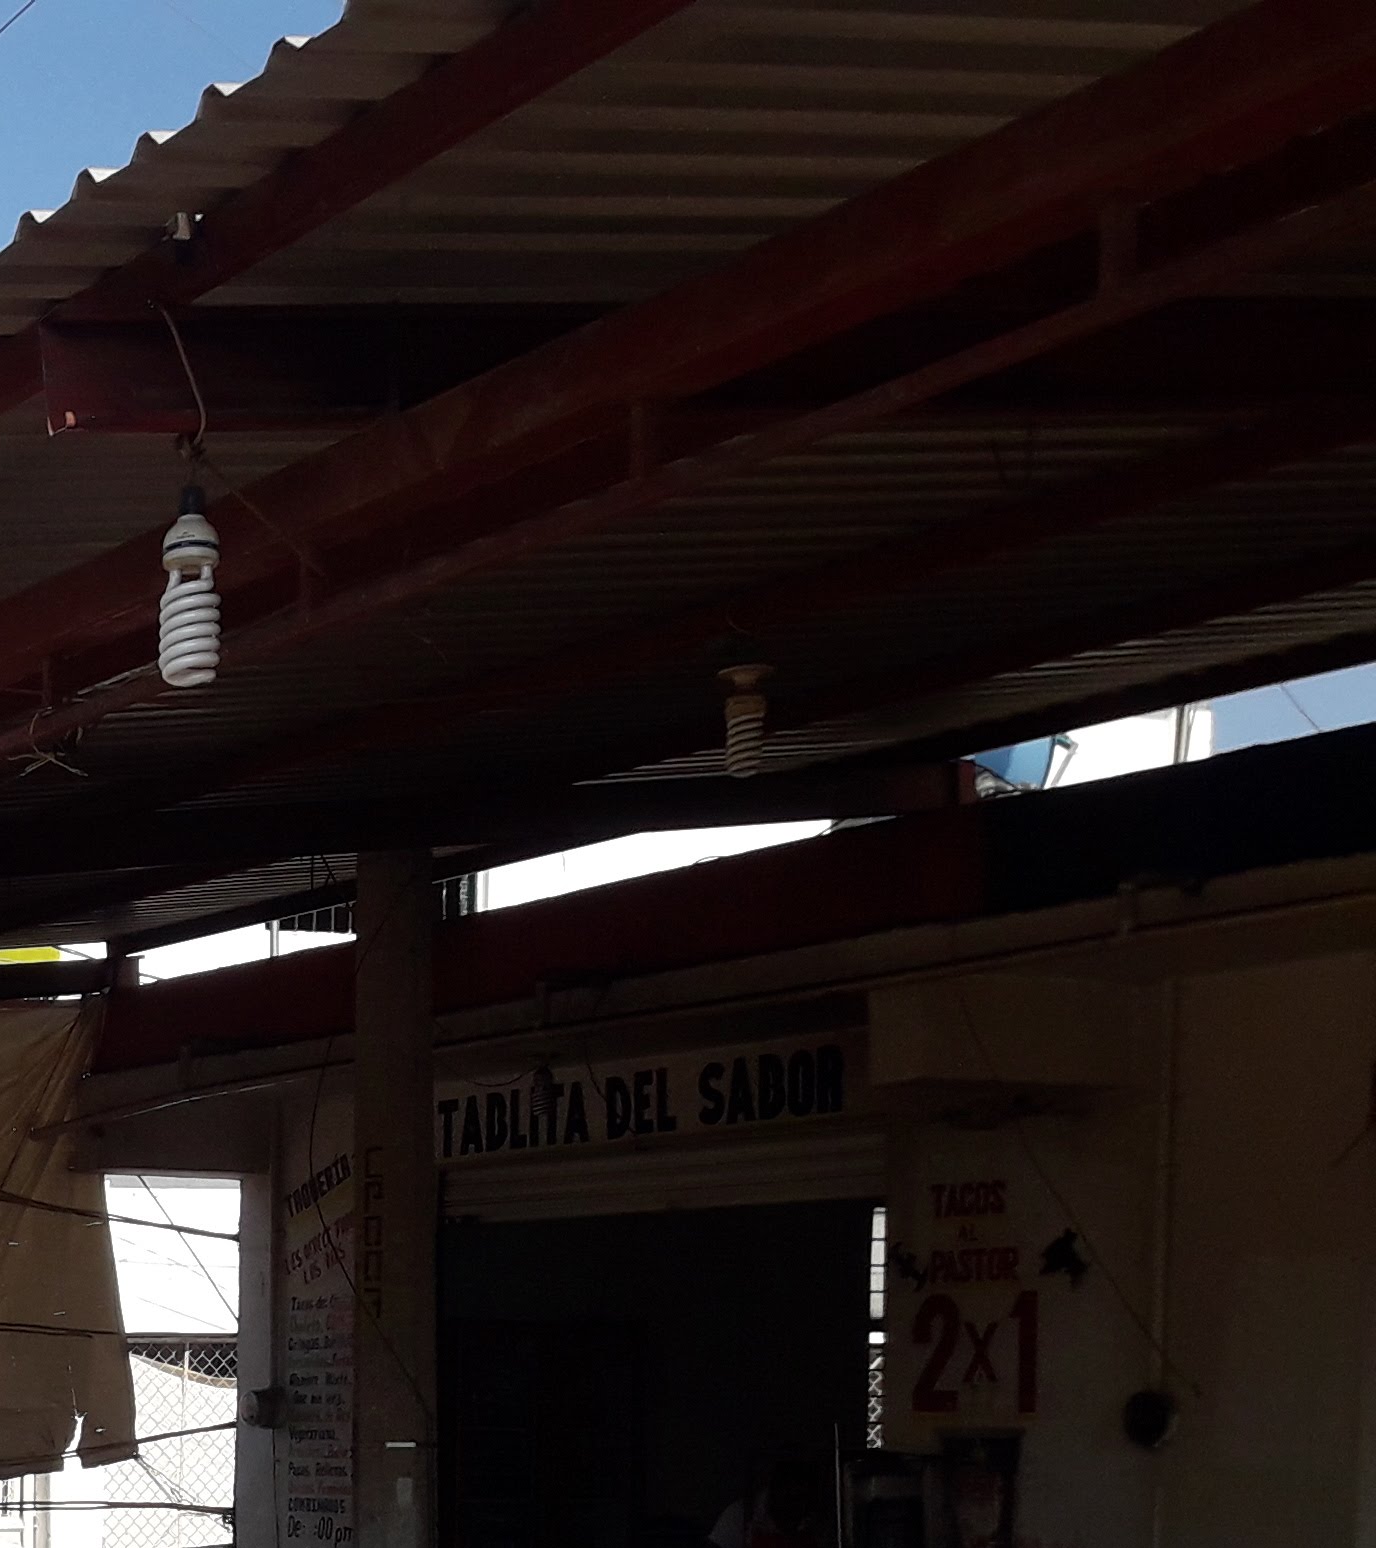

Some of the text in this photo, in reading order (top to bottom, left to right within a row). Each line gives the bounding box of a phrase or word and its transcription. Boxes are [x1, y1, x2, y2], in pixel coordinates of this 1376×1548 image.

[438, 1044, 845, 1158] TABLITA DEL SABOR
[930, 1180, 1007, 1219] TACOS
[929, 1247, 1019, 1285] PASTOR
